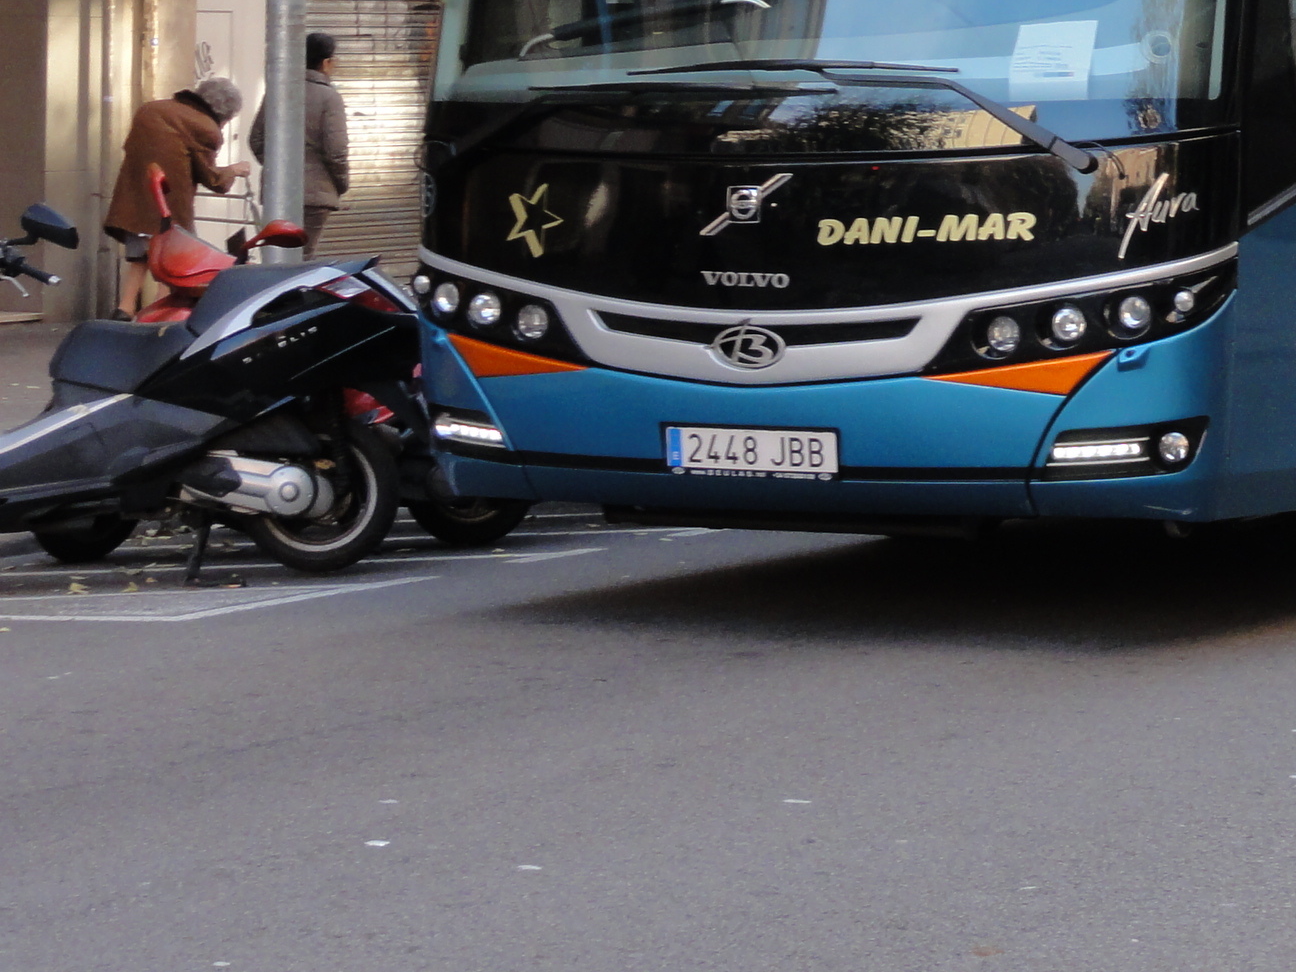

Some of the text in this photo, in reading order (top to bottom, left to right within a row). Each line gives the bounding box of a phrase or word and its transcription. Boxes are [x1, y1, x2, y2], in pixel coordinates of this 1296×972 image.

[817, 212, 1037, 246] DANI-MAR
[1118, 172, 1200, 259] Aura
[700, 270, 790, 289] VOLVO
[687, 433, 825, 468] 2448 JBB
